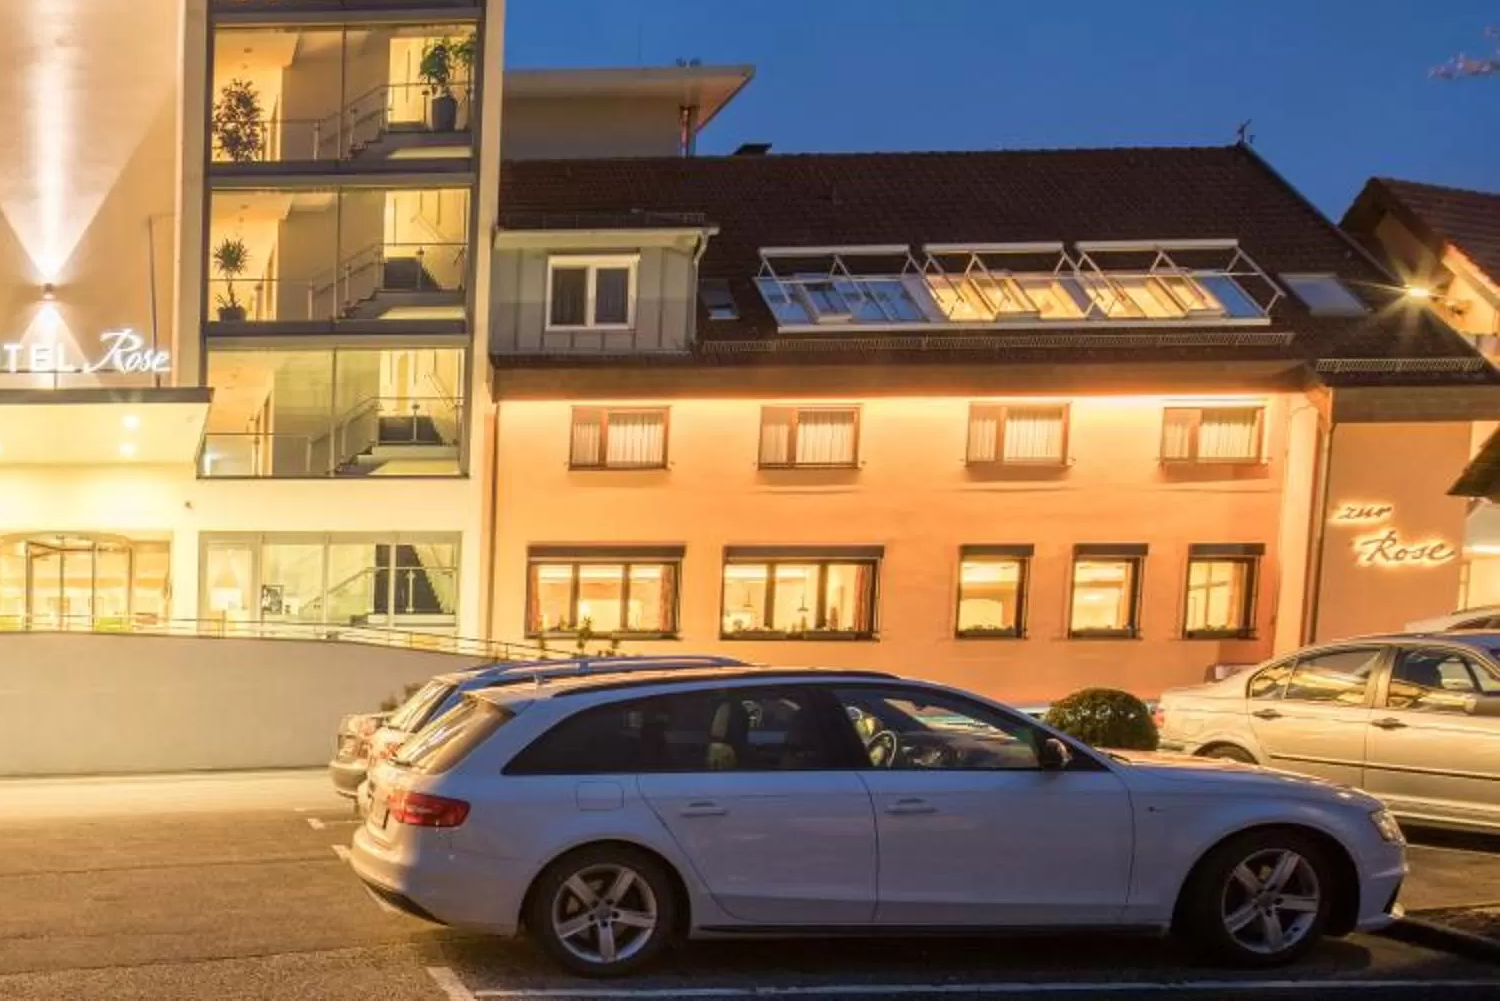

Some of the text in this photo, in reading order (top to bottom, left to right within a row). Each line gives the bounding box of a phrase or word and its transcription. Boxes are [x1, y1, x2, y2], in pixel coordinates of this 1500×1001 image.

[82, 327, 172, 375] Rose
[1336, 504, 1392, 521] zur
[1356, 530, 1457, 564] Rose
